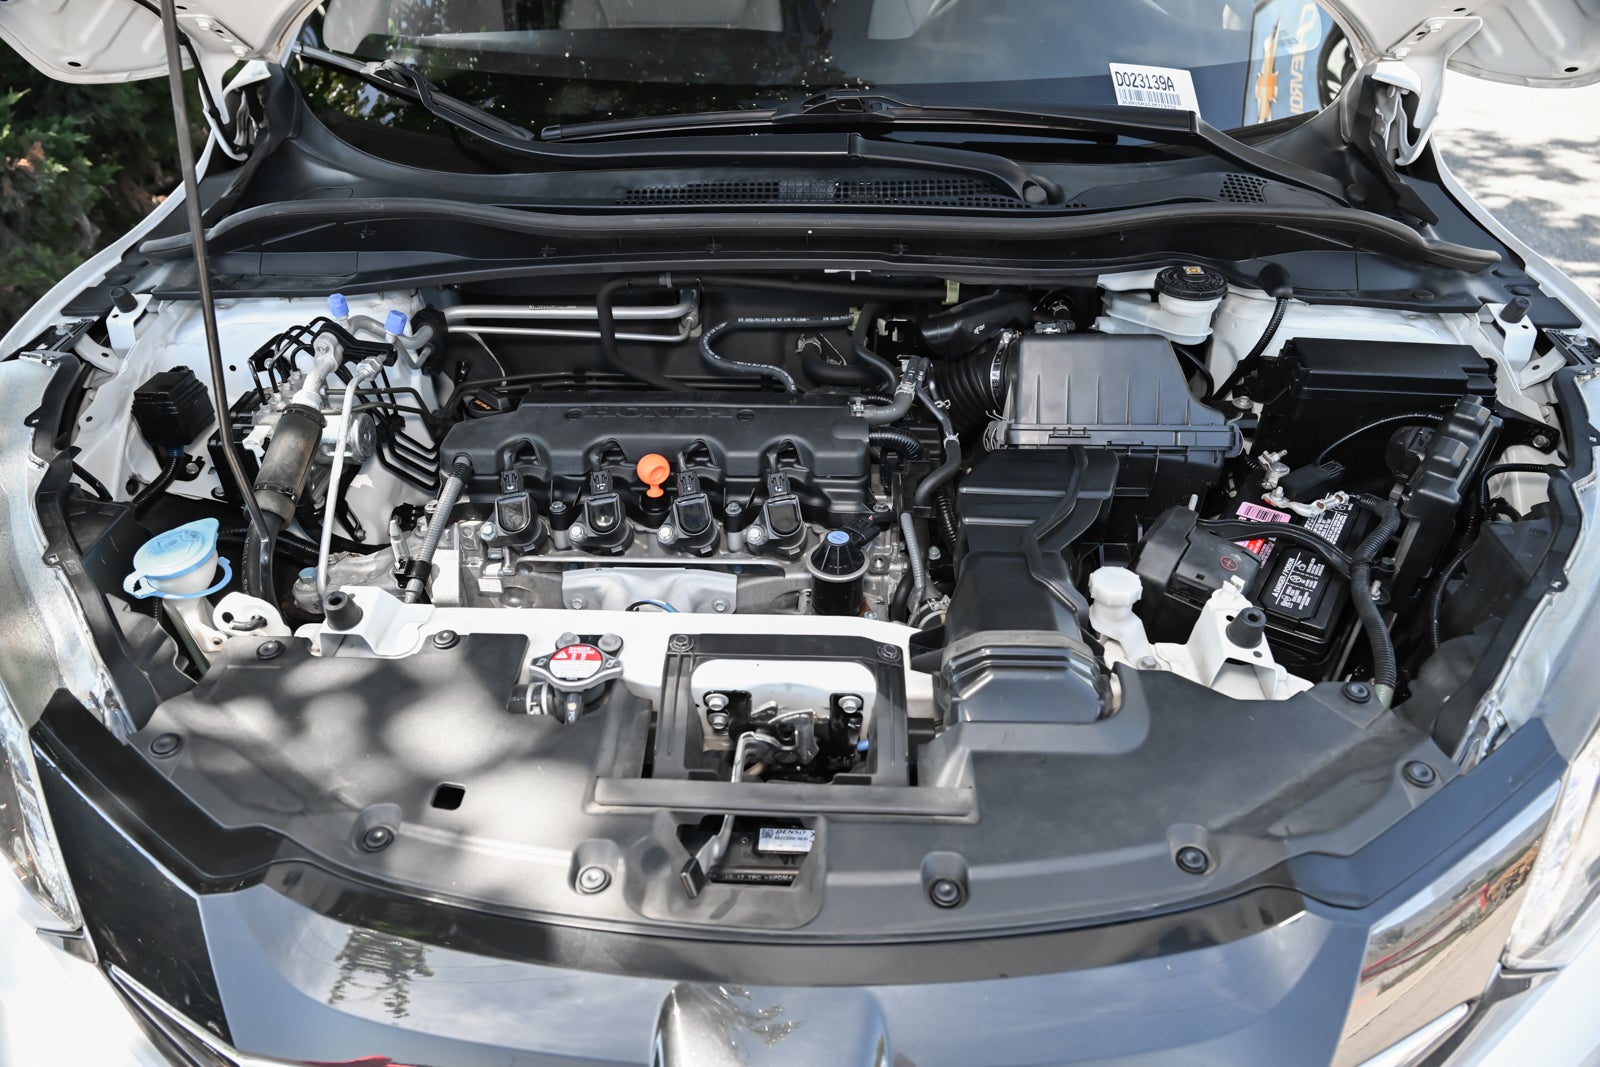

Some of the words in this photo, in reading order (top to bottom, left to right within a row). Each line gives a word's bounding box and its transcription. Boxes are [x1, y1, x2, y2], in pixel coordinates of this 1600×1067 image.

[1115, 71, 1175, 92] D023139A
[584, 406, 734, 418] HONDA
[774, 828, 807, 836] DENSO
